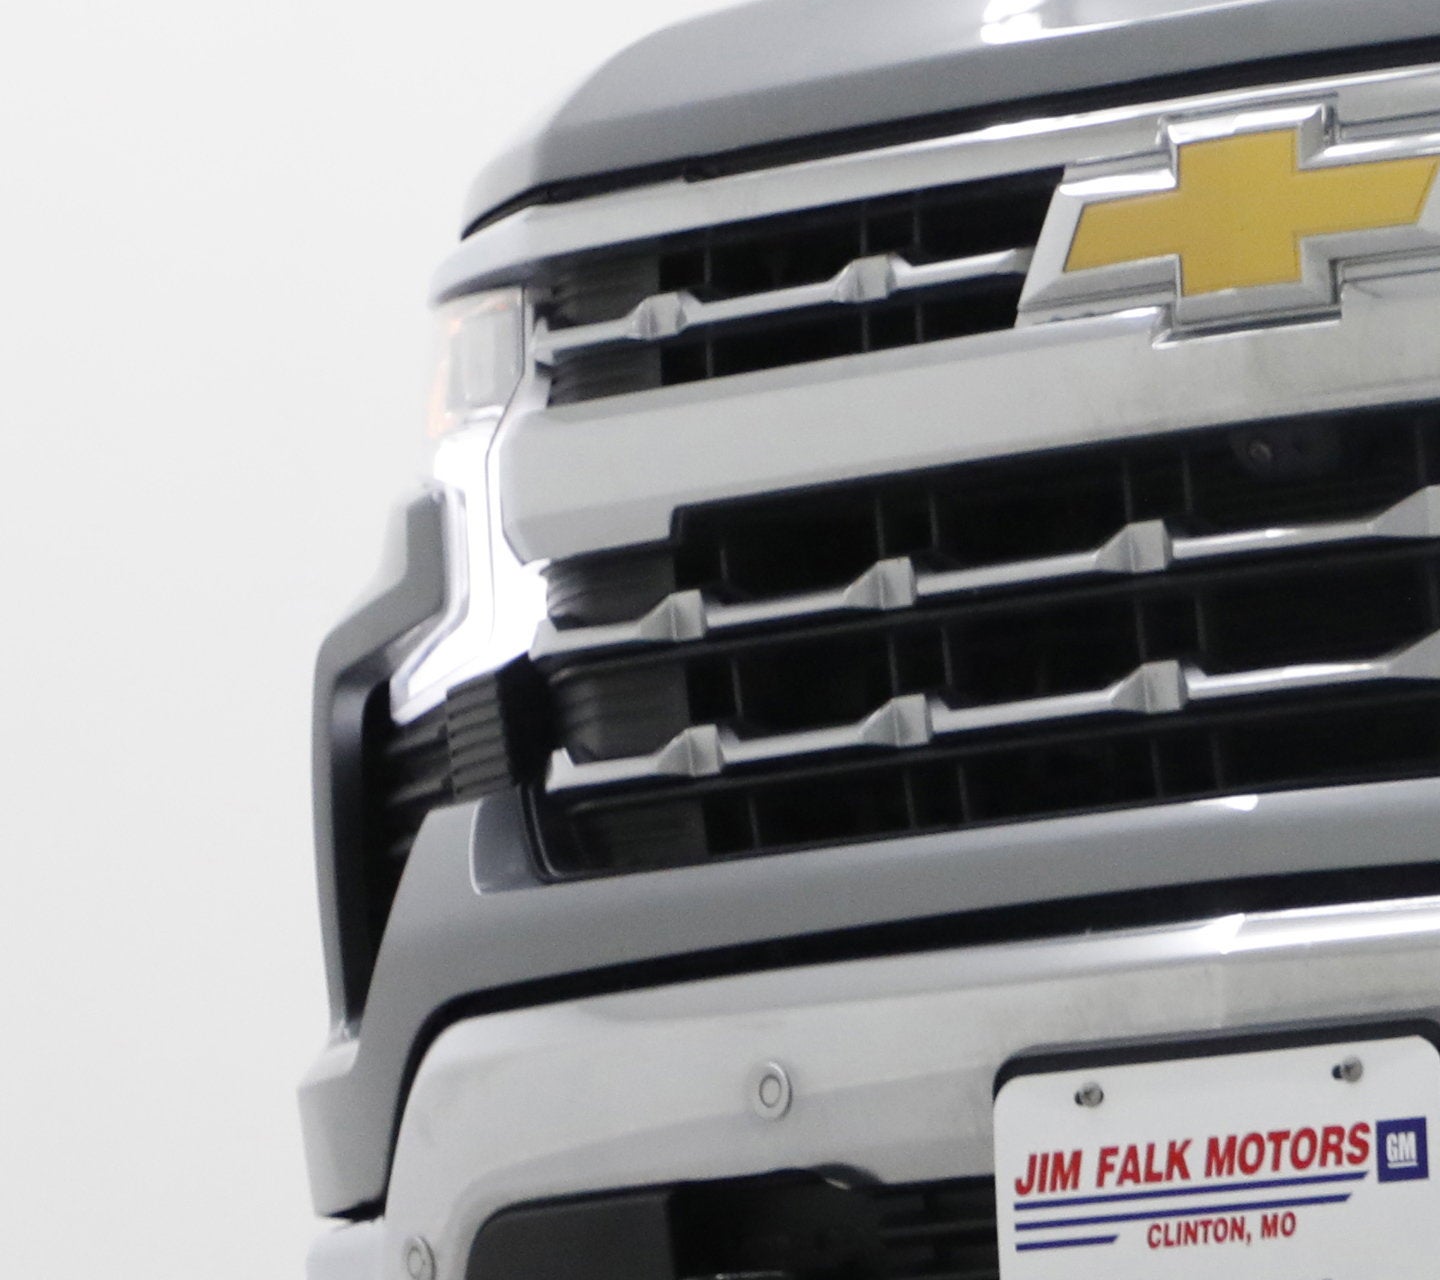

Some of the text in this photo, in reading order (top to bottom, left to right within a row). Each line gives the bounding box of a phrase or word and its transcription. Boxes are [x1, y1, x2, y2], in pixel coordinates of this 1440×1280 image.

[1015, 1122, 1371, 1196] JIM FALK MOTORS
[1385, 1131, 1418, 1165] GM
[1147, 1211, 1297, 1249] CLINTON, MO
